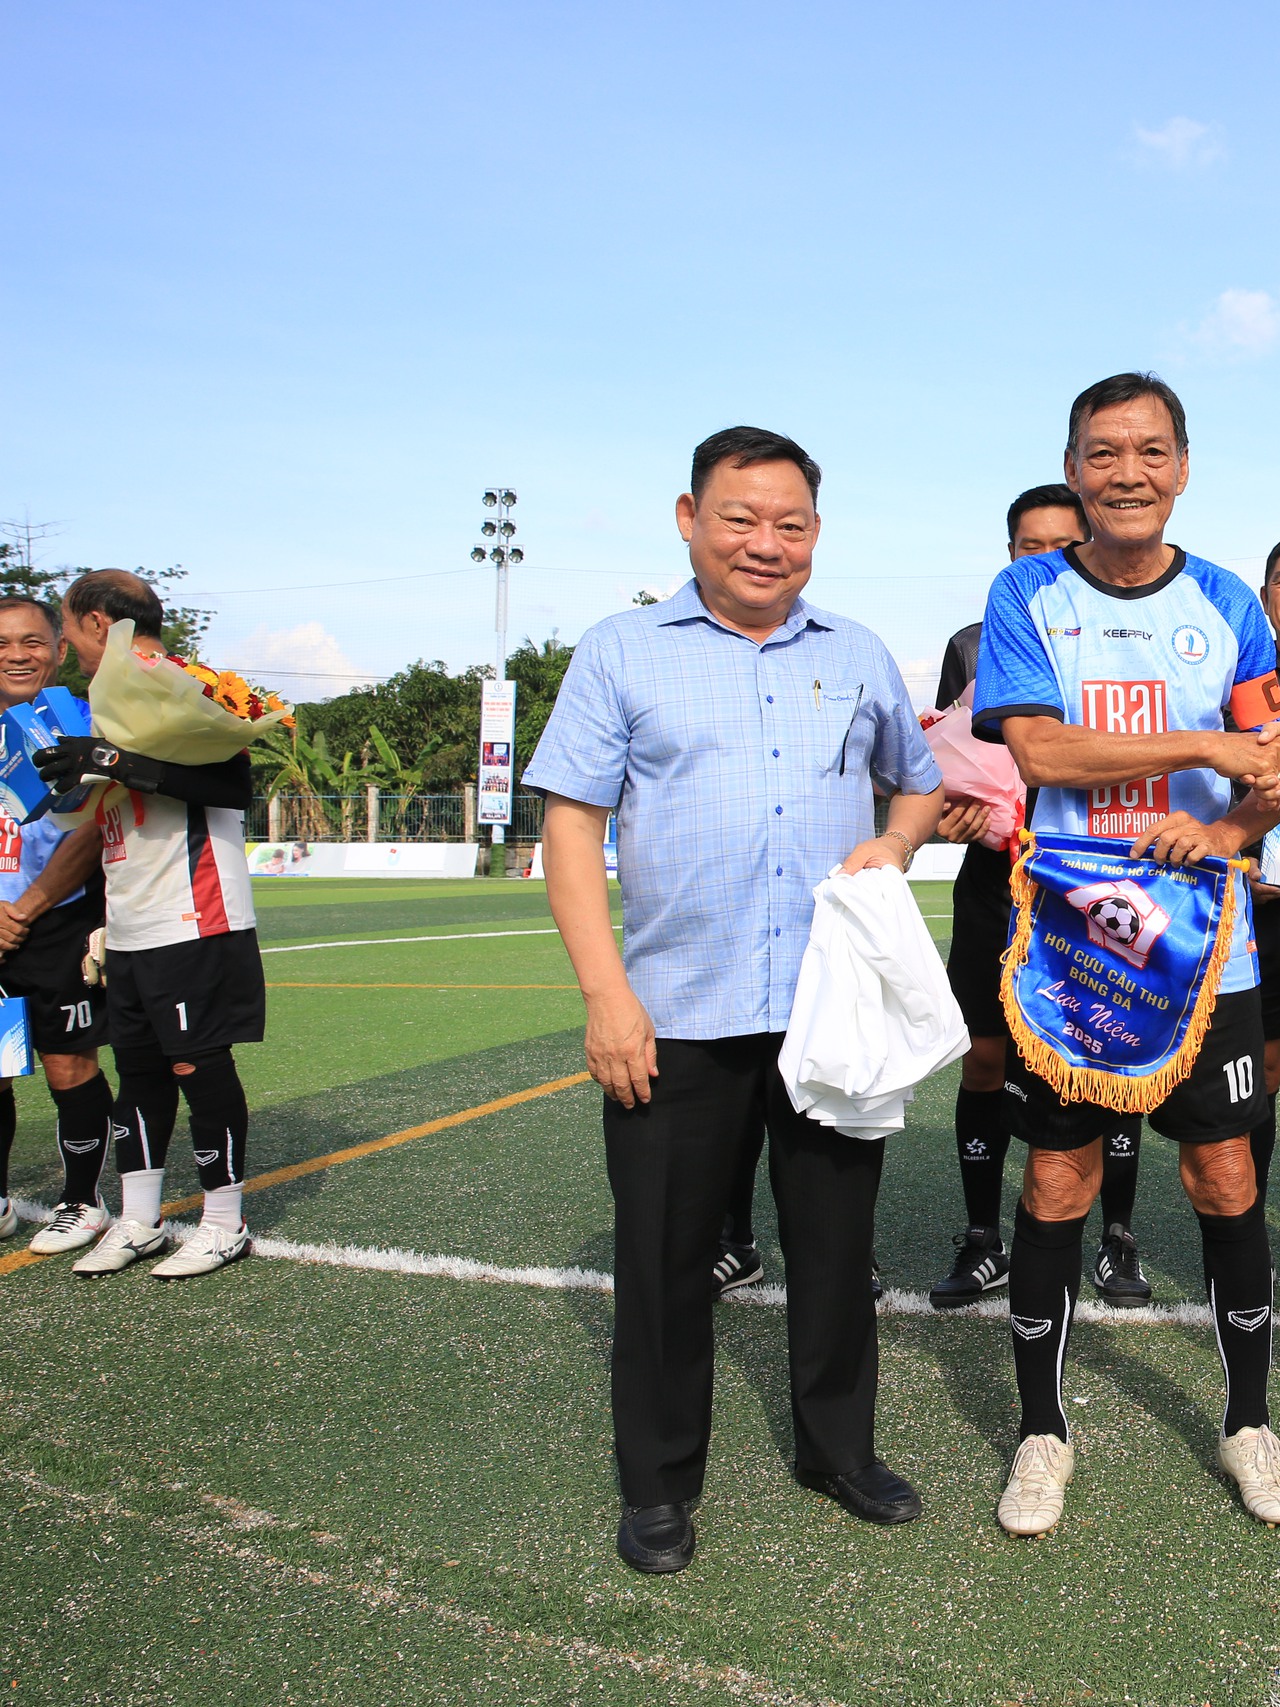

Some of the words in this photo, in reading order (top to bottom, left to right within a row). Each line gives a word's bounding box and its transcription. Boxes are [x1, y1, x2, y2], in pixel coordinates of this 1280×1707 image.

[1103, 629, 1153, 641] KEEPFLY
[1061, 859, 1098, 872] THÀNH
[1101, 863, 1124, 876] PHỐ
[1169, 871, 1198, 886] MINH
[1044, 932, 1071, 955] HỘI
[1073, 949, 1105, 974] CỰU
[1107, 969, 1137, 994] CẦU
[1139, 986, 1169, 1011] THỦ
[1069, 966, 1109, 997] BÓNG
[1112, 991, 1133, 1012] ĐÁ
[60, 1000, 92, 1032] 70
[175, 1001, 188, 1031] 1
[1036, 979, 1082, 1013] Lưu
[1088, 1002, 1141, 1047] Niệm
[1062, 1021, 1104, 1055] 2025
[1223, 1055, 1253, 1104] 10
